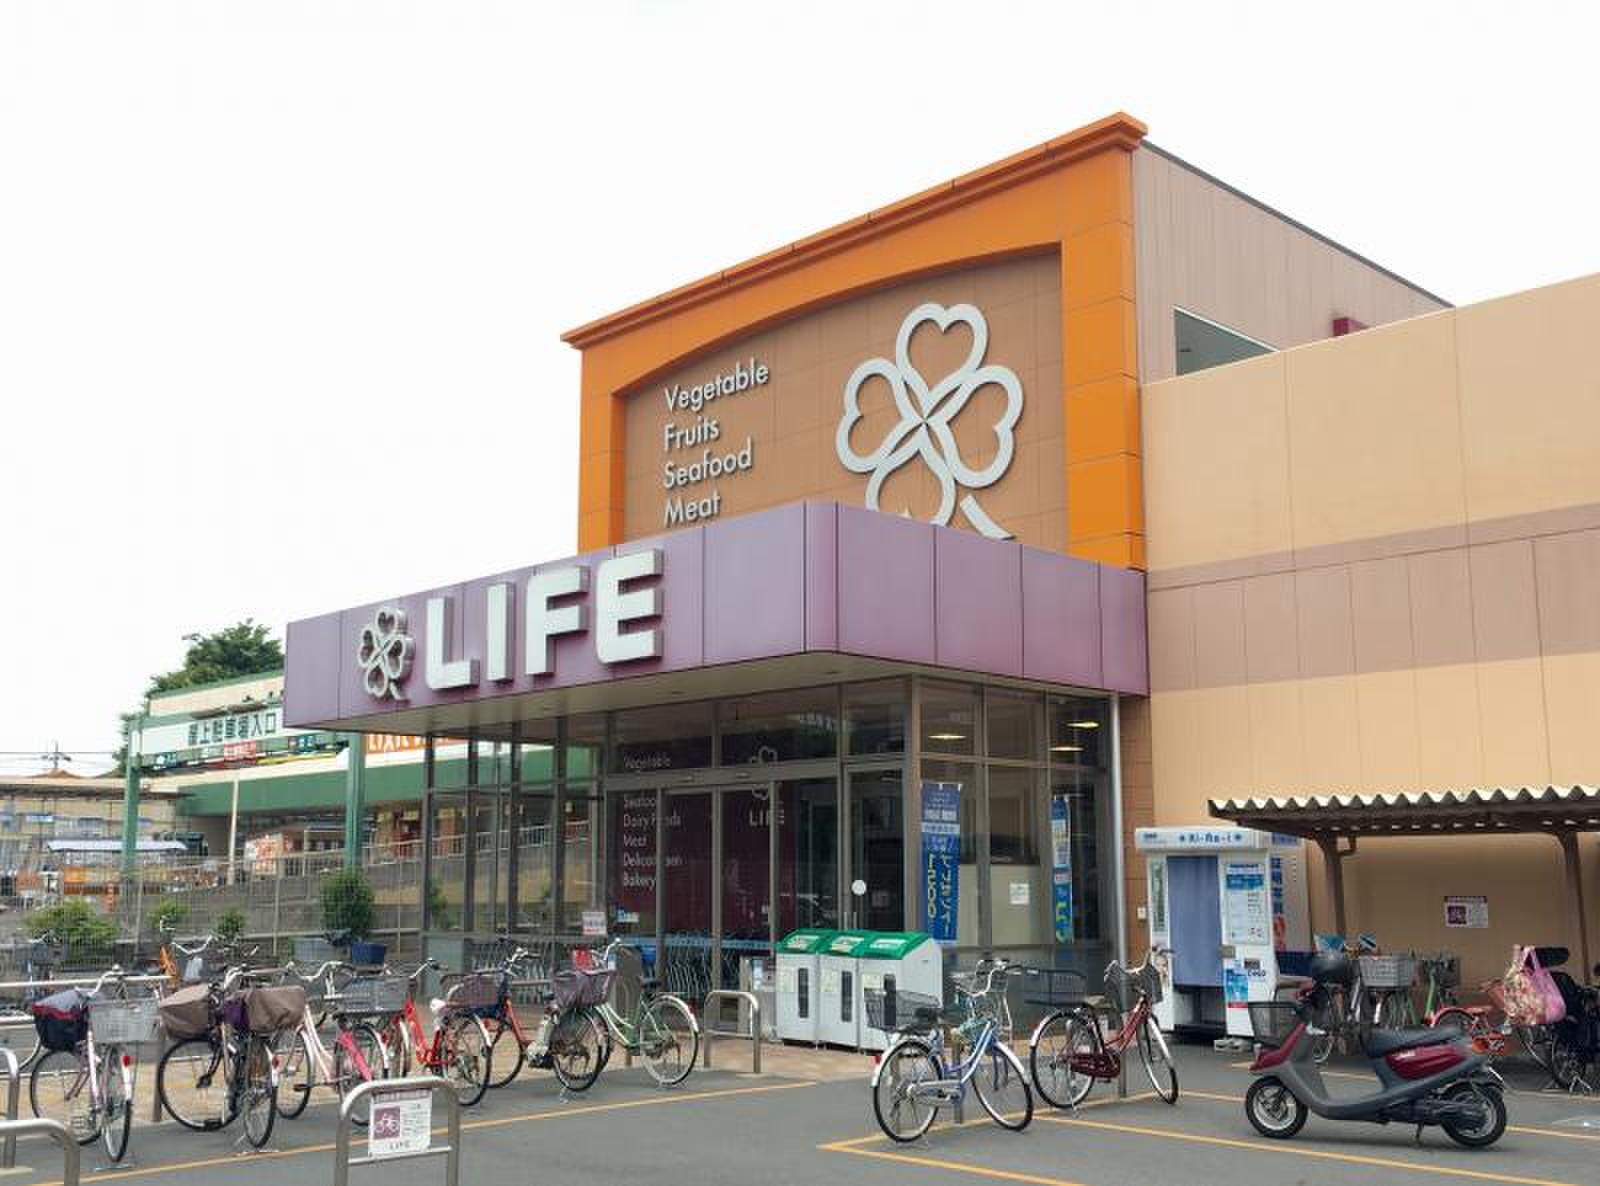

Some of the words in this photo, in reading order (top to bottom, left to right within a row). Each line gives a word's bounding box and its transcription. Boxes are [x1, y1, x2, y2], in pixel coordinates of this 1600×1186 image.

[665, 357, 769, 412] Vegetable
[664, 415, 719, 451] Fruits
[663, 436, 752, 489] Seafood
[664, 489, 721, 529] Meat
[426, 549, 663, 690] LIFE
